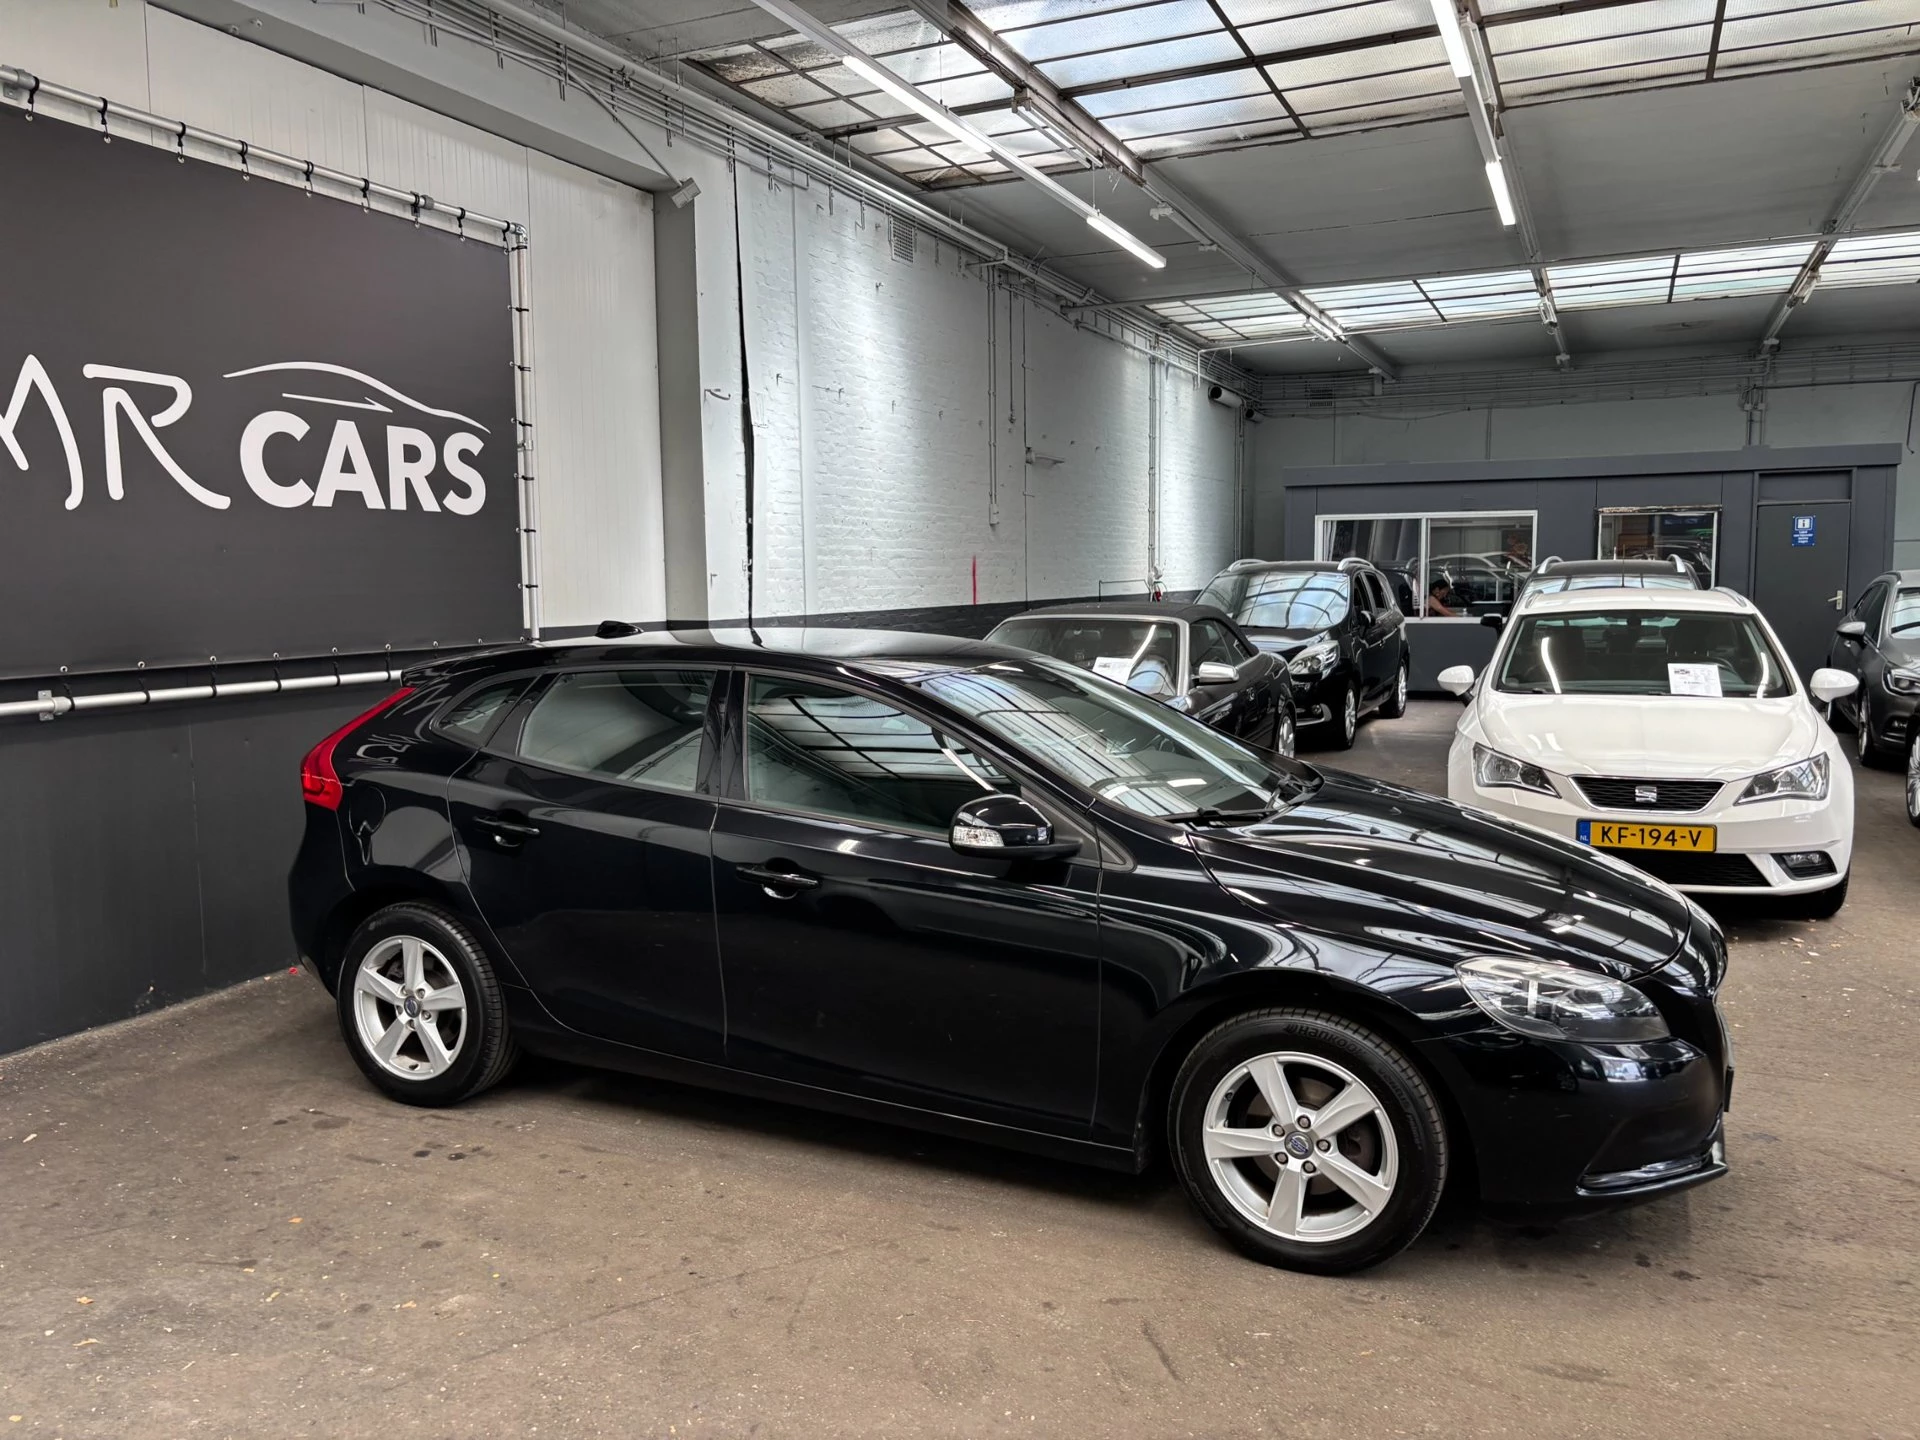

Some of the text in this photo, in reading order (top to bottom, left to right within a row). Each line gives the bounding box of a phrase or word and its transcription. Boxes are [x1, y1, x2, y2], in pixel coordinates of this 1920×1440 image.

[239, 410, 487, 516] CARS
[1579, 825, 1702, 848] NL KF-194-V
